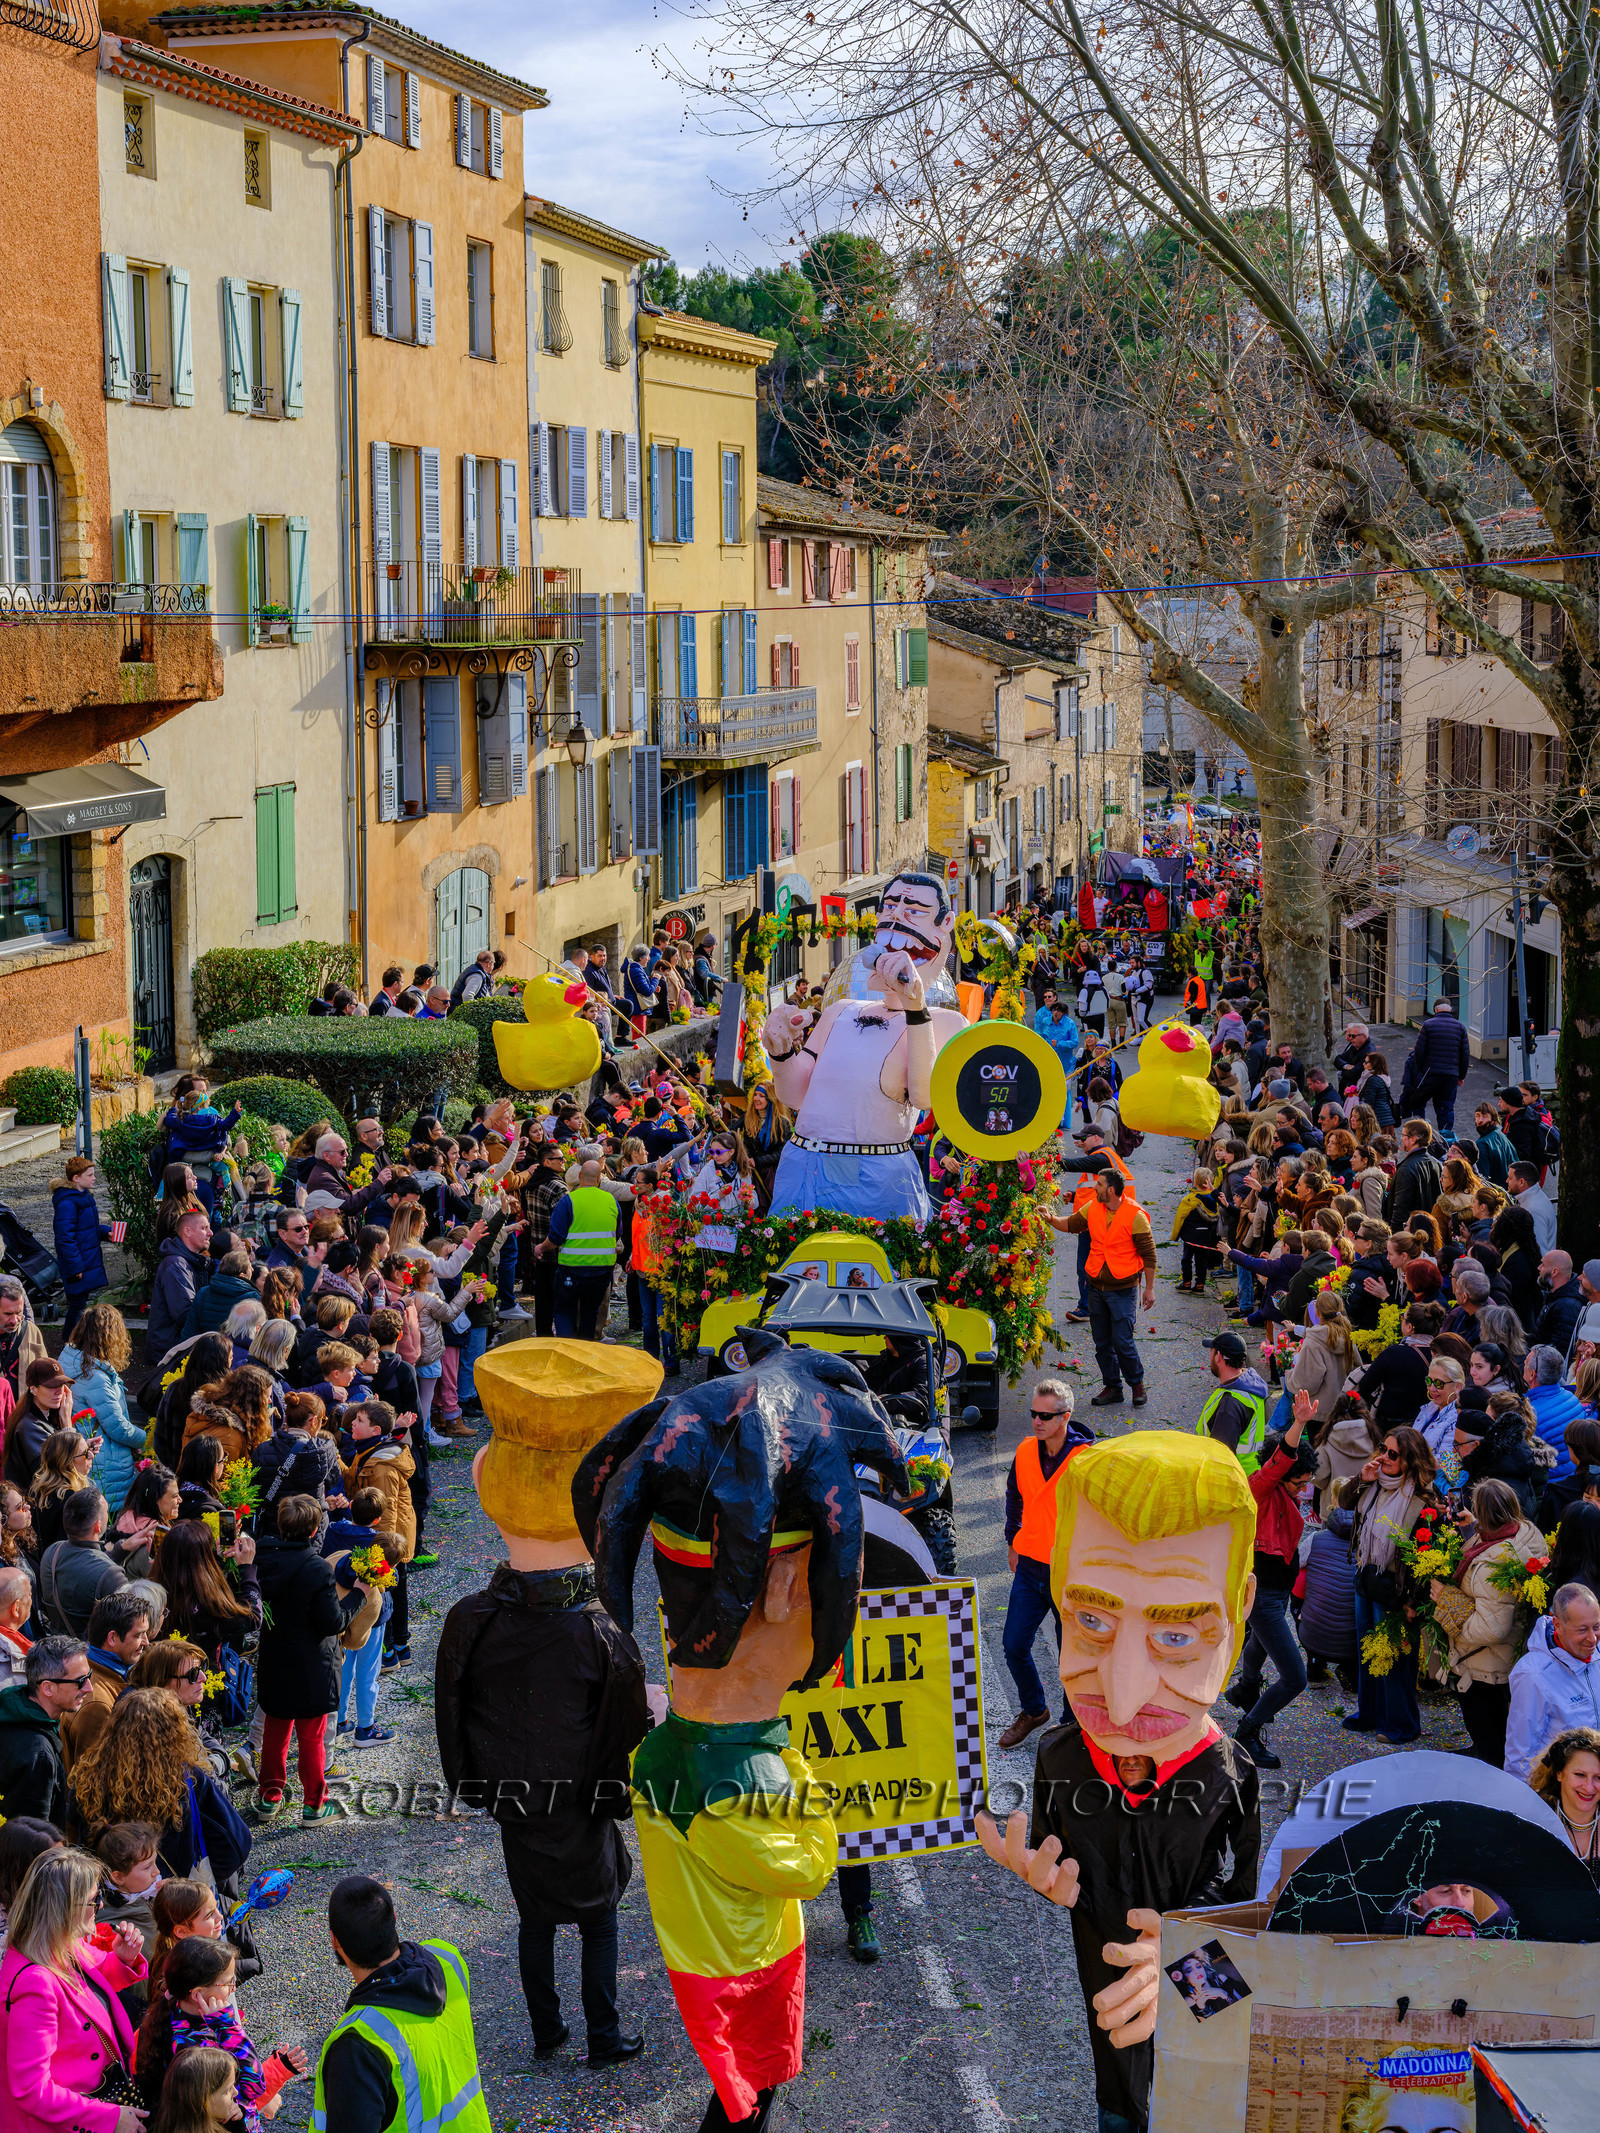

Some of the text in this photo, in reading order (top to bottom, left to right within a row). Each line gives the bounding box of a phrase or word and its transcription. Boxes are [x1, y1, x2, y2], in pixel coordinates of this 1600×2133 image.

[79, 801, 132, 818] MAGREY & SONS
[671, 920, 683, 937] B
[989, 1086, 1010, 1103] 50
[781, 1700, 908, 1760] AXI
[828, 1777, 924, 1808] PARADIS
[1383, 2054, 1469, 2075] MADONNA
[1392, 2075, 1463, 2087] CELEBRATION
